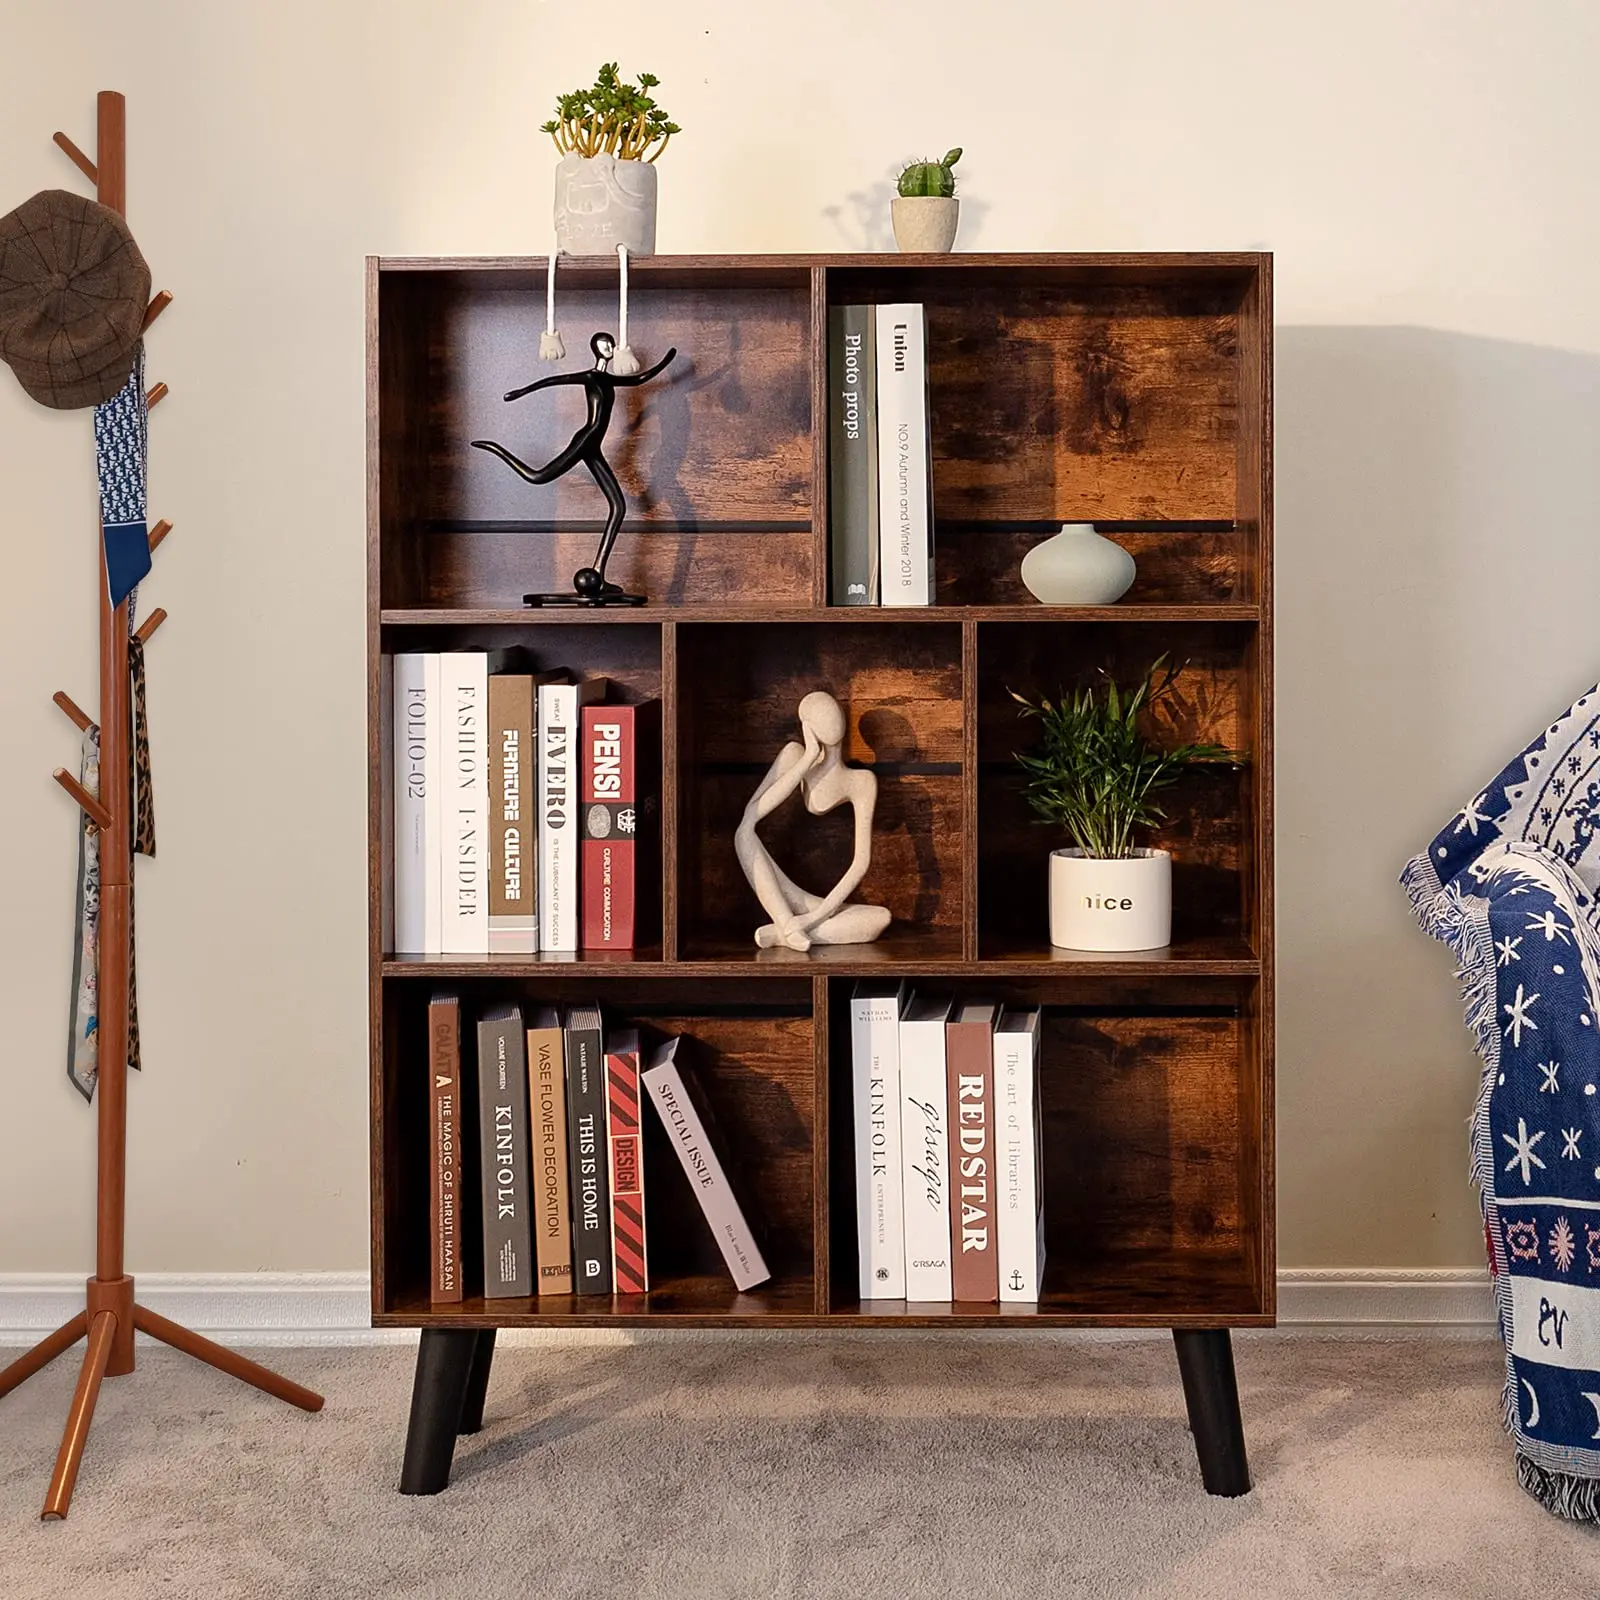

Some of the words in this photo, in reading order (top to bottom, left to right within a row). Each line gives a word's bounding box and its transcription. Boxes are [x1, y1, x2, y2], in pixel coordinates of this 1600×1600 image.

[845, 333, 861, 384] Photo
[894, 323, 907, 372] Union
[842, 391, 859, 440] props
[898, 423, 909, 450] NO.9
[898, 453, 909, 496] Autumn
[899, 498, 910, 521] and
[900, 523, 911, 556] Winter
[901, 559, 912, 586] 2018
[554, 697, 562, 722] SWEAT
[408, 687, 427, 799] FOLIO-02
[458, 687, 476, 789] FASHION
[593, 723, 621, 798] PENSI
[502, 729, 520, 821] FURNITURE
[504, 828, 521, 900] CULTURE
[553, 902, 560, 912] OF
[552, 914, 560, 947] SUCCESS
[538, 1044, 551, 1080] VASE
[1007, 1052, 1018, 1076] The
[443, 1095, 452, 1116] THE
[540, 1086, 554, 1144] FLOWER
[1007, 1083, 1017, 1106] art
[443, 1122, 453, 1165] MAGIC
[579, 1114, 593, 1154] THIS
[658, 1083, 693, 1147] SPECIAL
[687, 1144, 714, 1189] ISSUE
[870, 1078, 887, 1177] KINFOLK
[1008, 1115, 1019, 1131] of
[443, 1171, 453, 1188] OF
[495, 1105, 515, 1218] KINFOLK
[581, 1158, 594, 1174] IS
[615, 1139, 636, 1192] DESIGN
[958, 1073, 989, 1254] REDSTAR
[1008, 1139, 1020, 1210] libraries
[444, 1193, 453, 1234] SHRUTI
[543, 1147, 560, 1238] DECORATION
[583, 1177, 599, 1231] HOME
[445, 1240, 454, 1290] HAASAN
